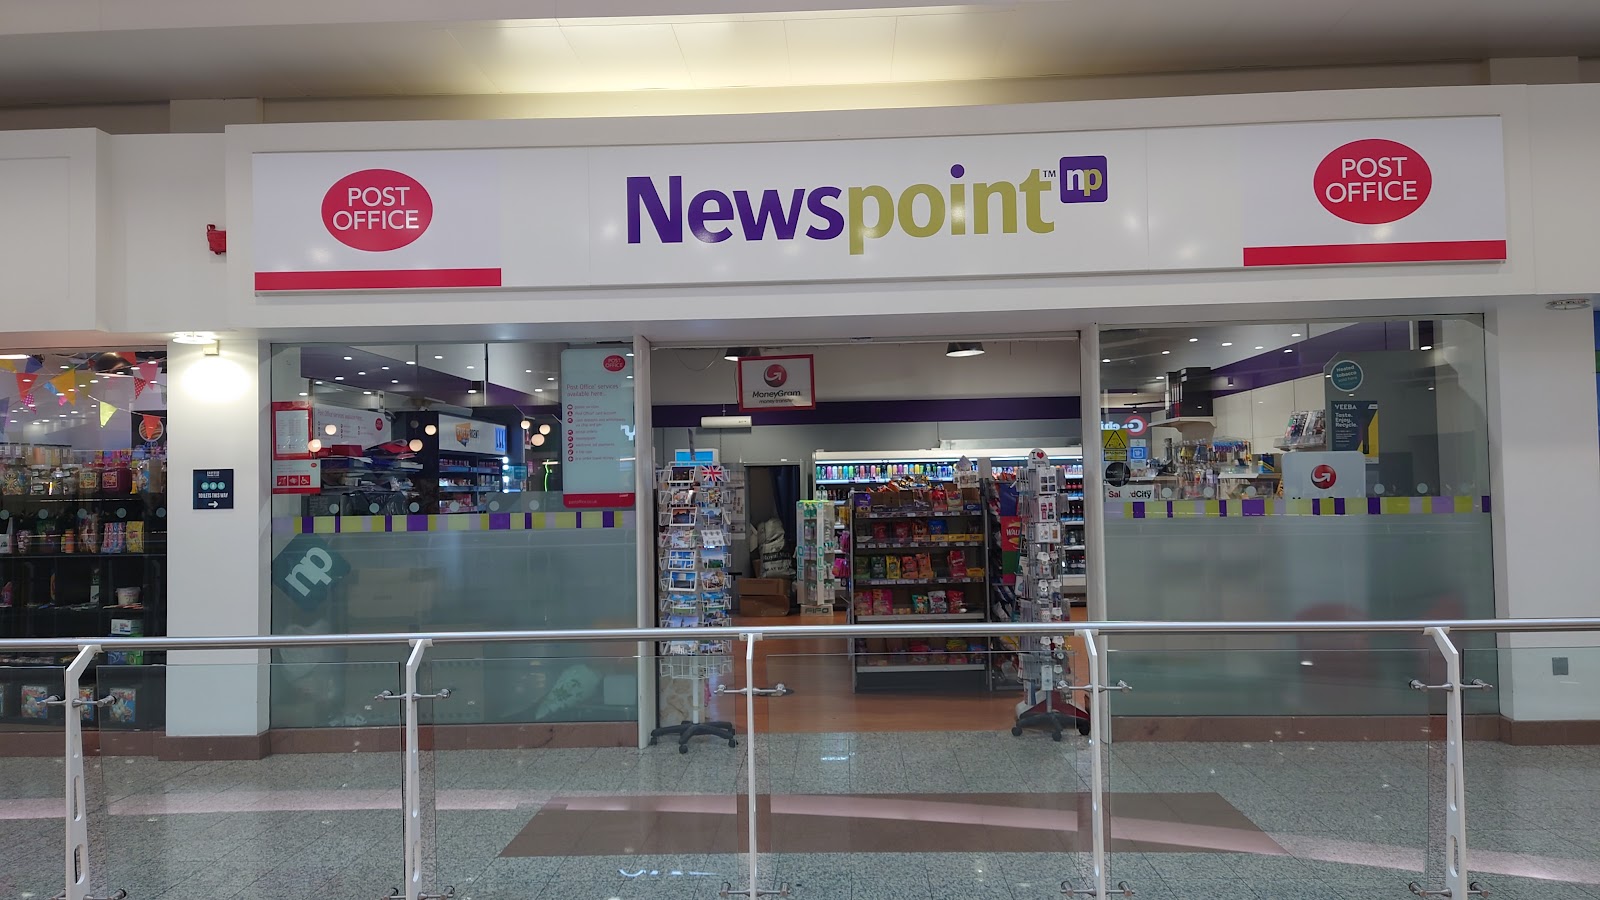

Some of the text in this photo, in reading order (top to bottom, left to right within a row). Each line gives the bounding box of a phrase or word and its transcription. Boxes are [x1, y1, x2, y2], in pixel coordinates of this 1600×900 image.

[1341, 156, 1408, 179] POST
[1066, 168, 1103, 197] np
[1325, 180, 1418, 204] OFFICE
[348, 186, 411, 207] POST
[332, 209, 420, 231] OFFICE
[625, 163, 1055, 255] Newspoint
[752, 389, 801, 399] MoneyGram
